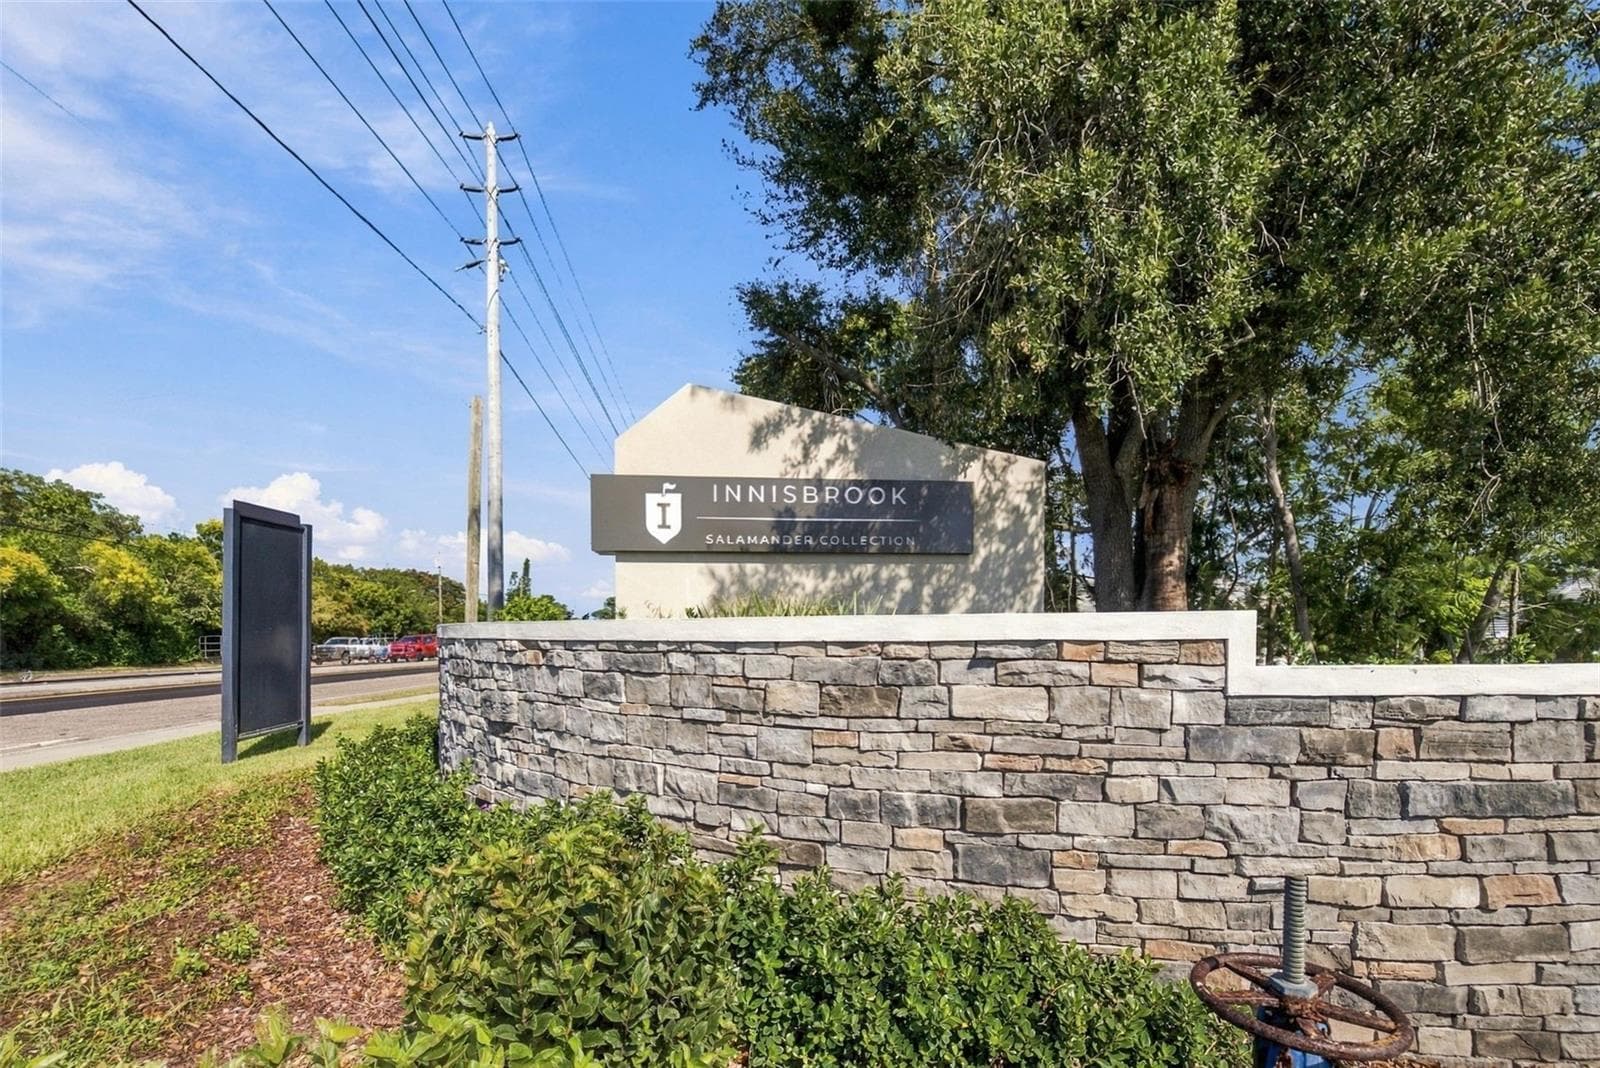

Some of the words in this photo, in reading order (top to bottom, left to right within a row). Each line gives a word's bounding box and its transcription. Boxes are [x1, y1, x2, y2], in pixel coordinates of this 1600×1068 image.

[713, 484, 907, 505] INNISBROOK
[656, 502, 671, 529] I
[704, 533, 814, 546] SALAMANDER
[819, 535, 916, 547] COLLECTION
